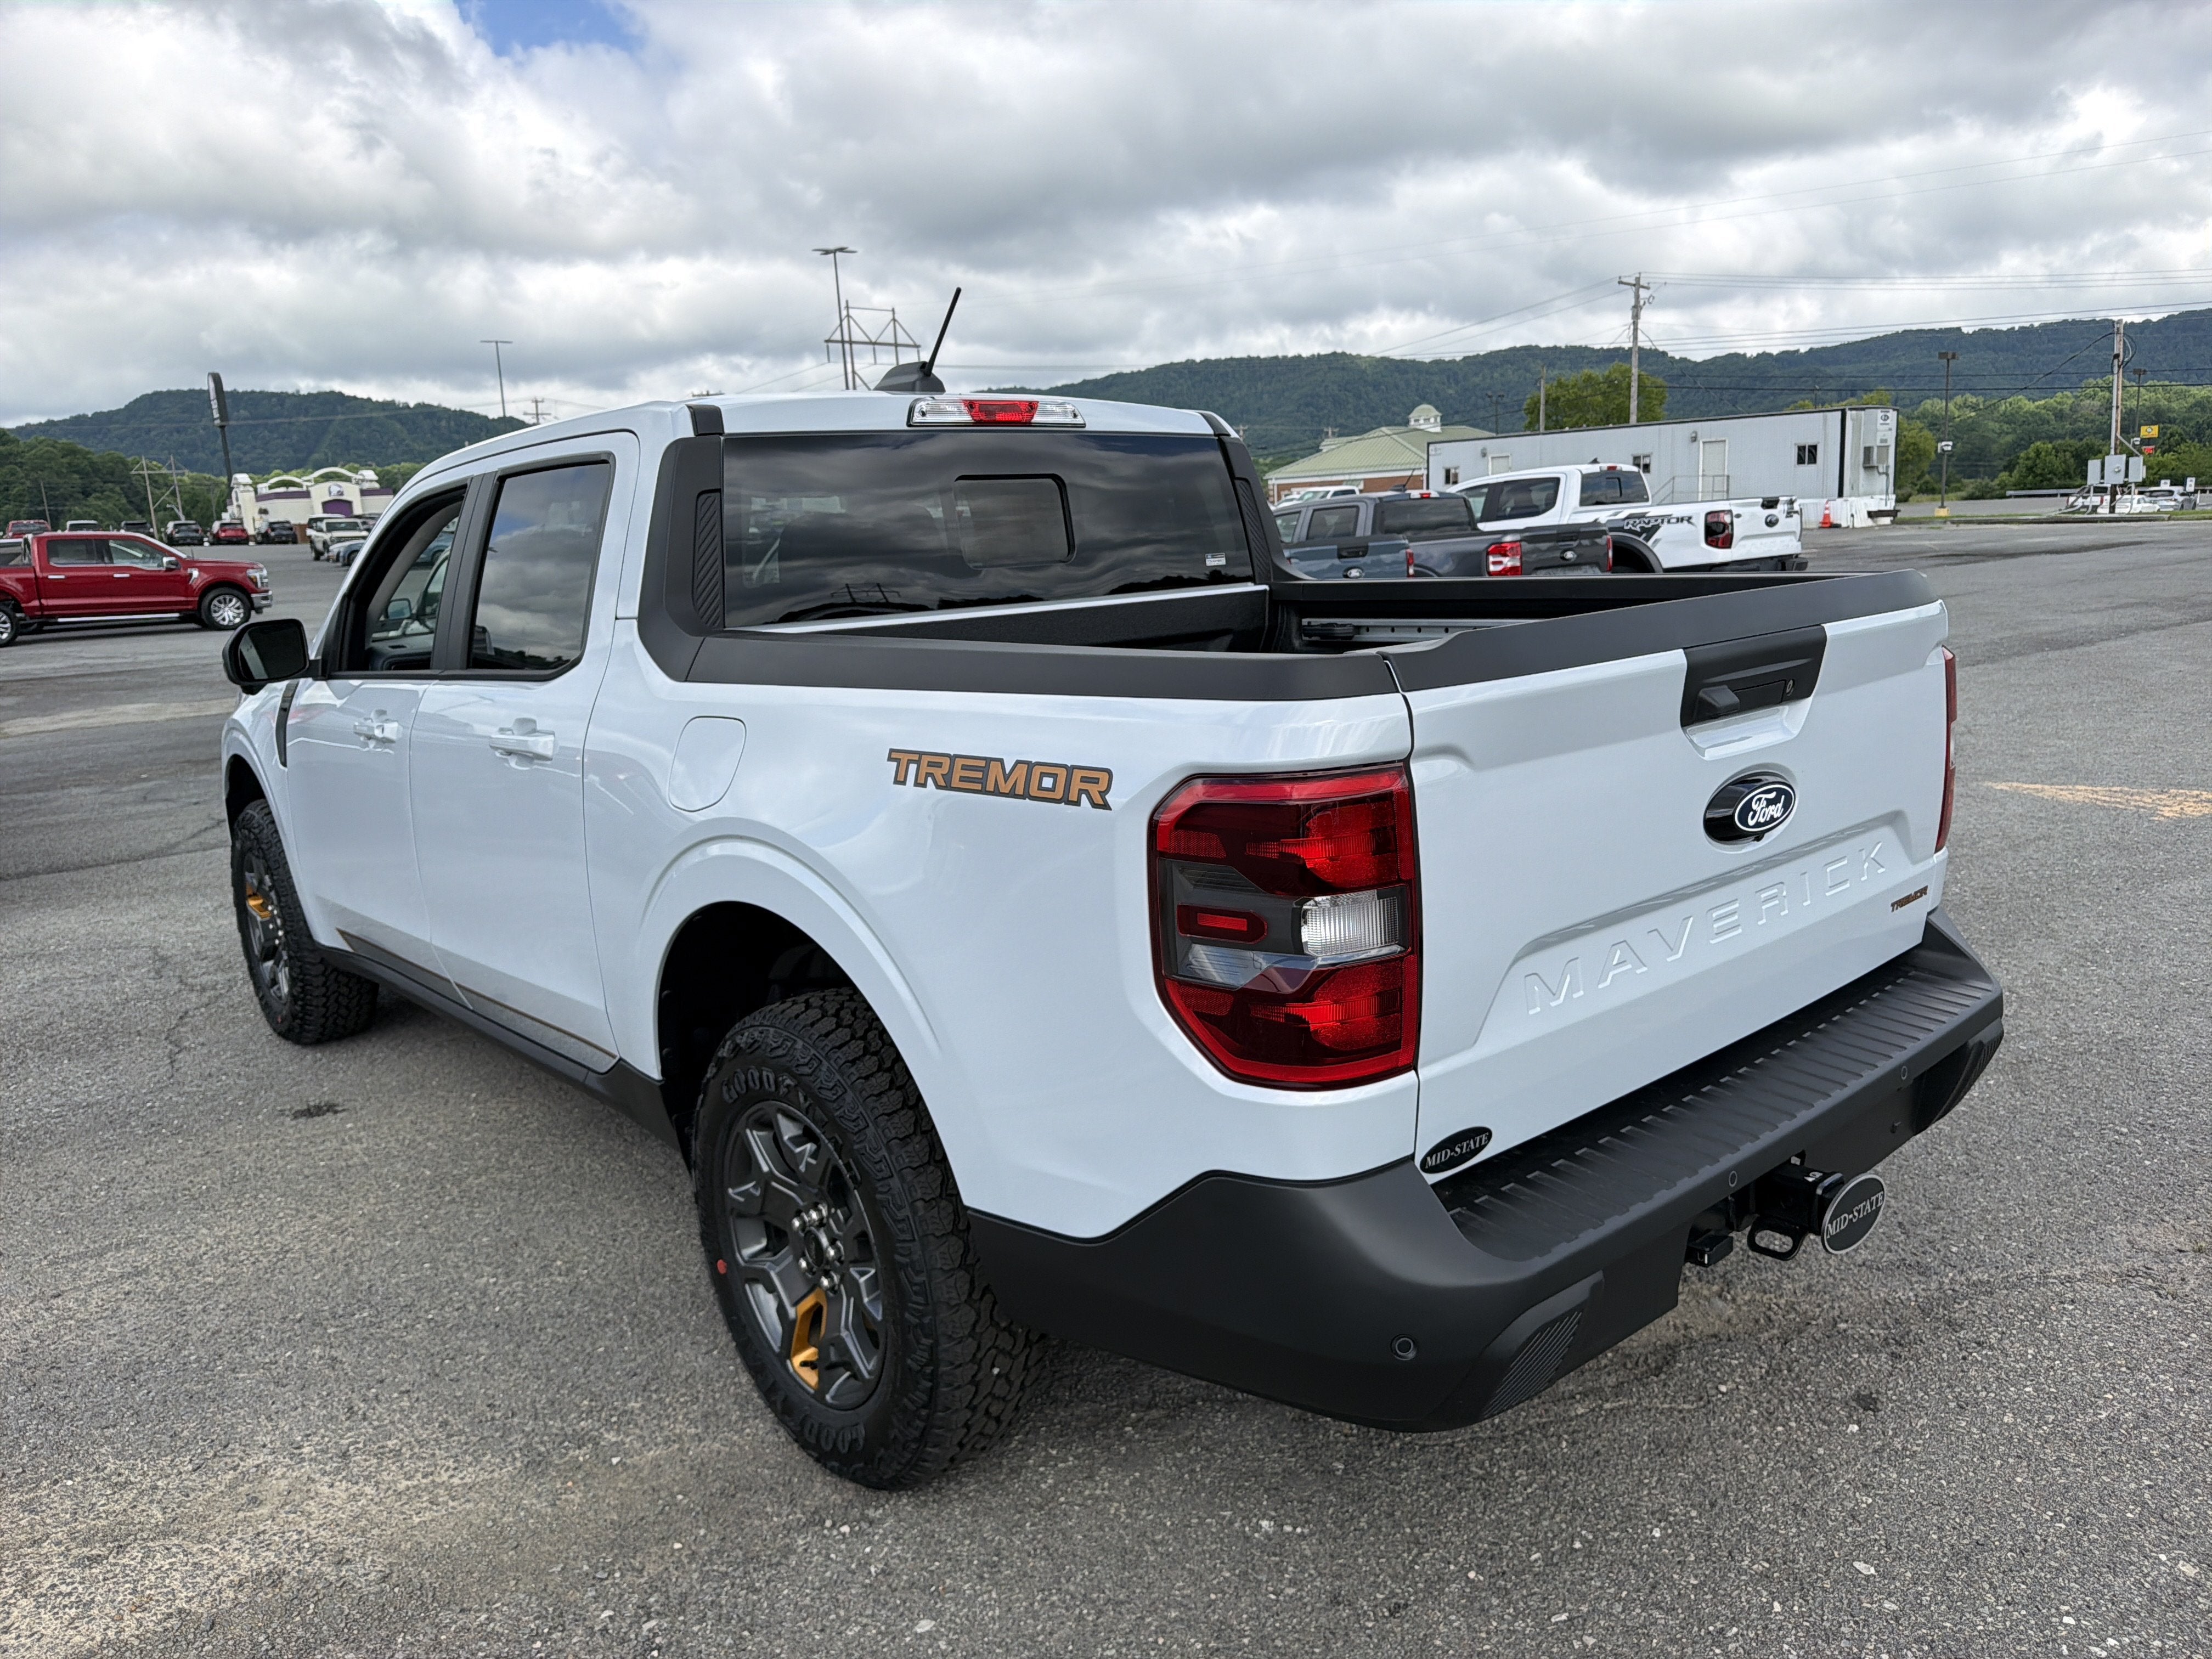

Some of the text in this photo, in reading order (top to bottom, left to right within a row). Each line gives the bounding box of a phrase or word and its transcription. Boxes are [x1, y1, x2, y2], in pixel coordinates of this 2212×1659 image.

[1623, 515, 1695, 531] RAPTOR
[887, 748, 1113, 810] TREMOR
[1748, 791, 1785, 826] Ford
[1891, 885, 1928, 912] TREMOR
[1524, 842, 1886, 1014] MAVERICK
[1425, 1132, 1489, 1169] MID-STATE
[1827, 1191, 1883, 1239] MID-STATE
